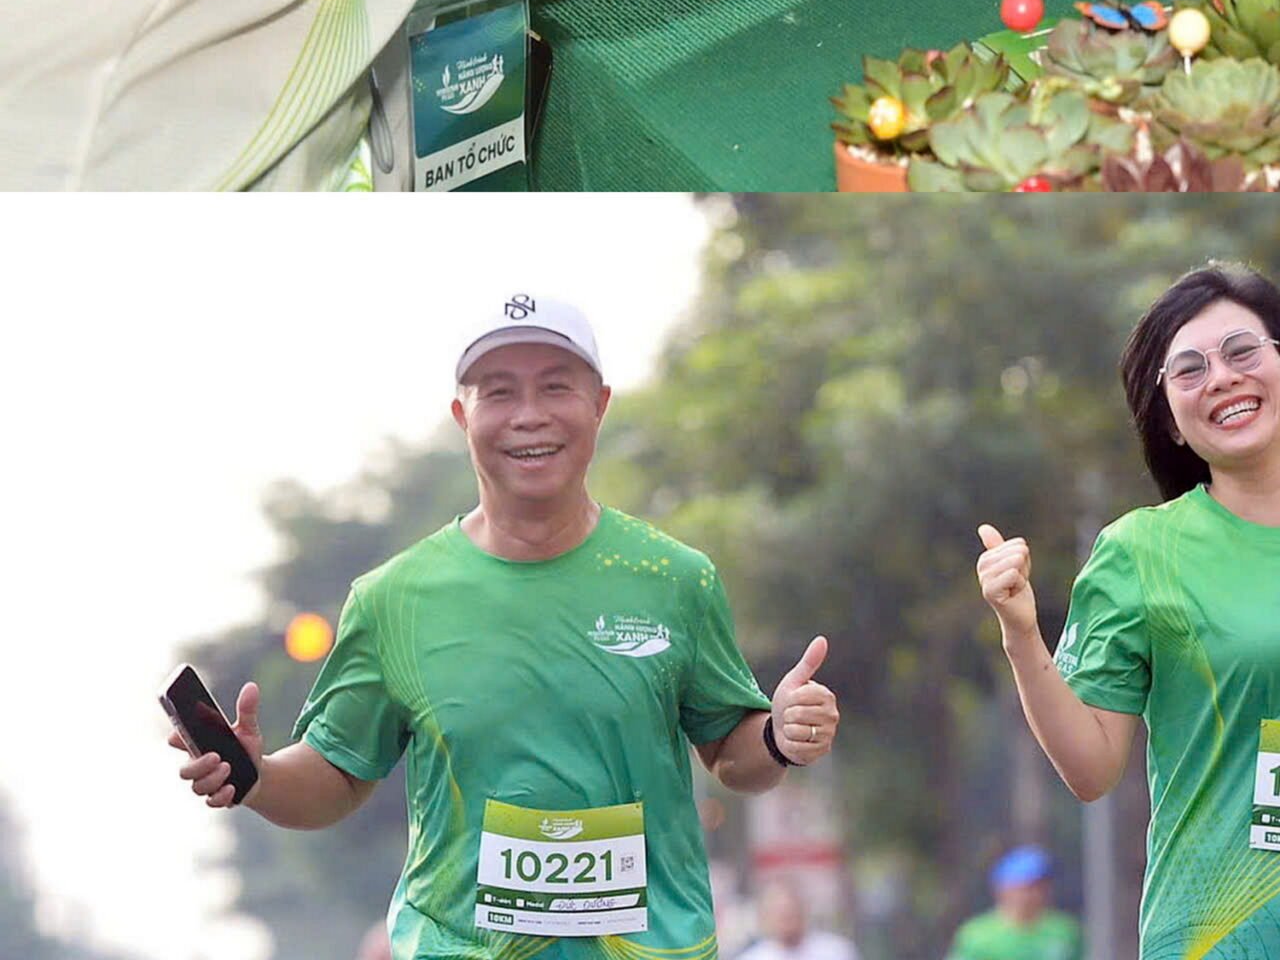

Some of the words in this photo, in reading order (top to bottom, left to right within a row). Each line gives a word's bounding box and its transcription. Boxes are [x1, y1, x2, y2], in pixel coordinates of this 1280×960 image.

[425, 162, 455, 189] BAN
[457, 142, 477, 175] TỔ
[478, 132, 516, 166] CHỨC
[616, 631, 649, 642] XANH
[500, 848, 612, 884] 10221
[489, 913, 513, 924] 10KM
